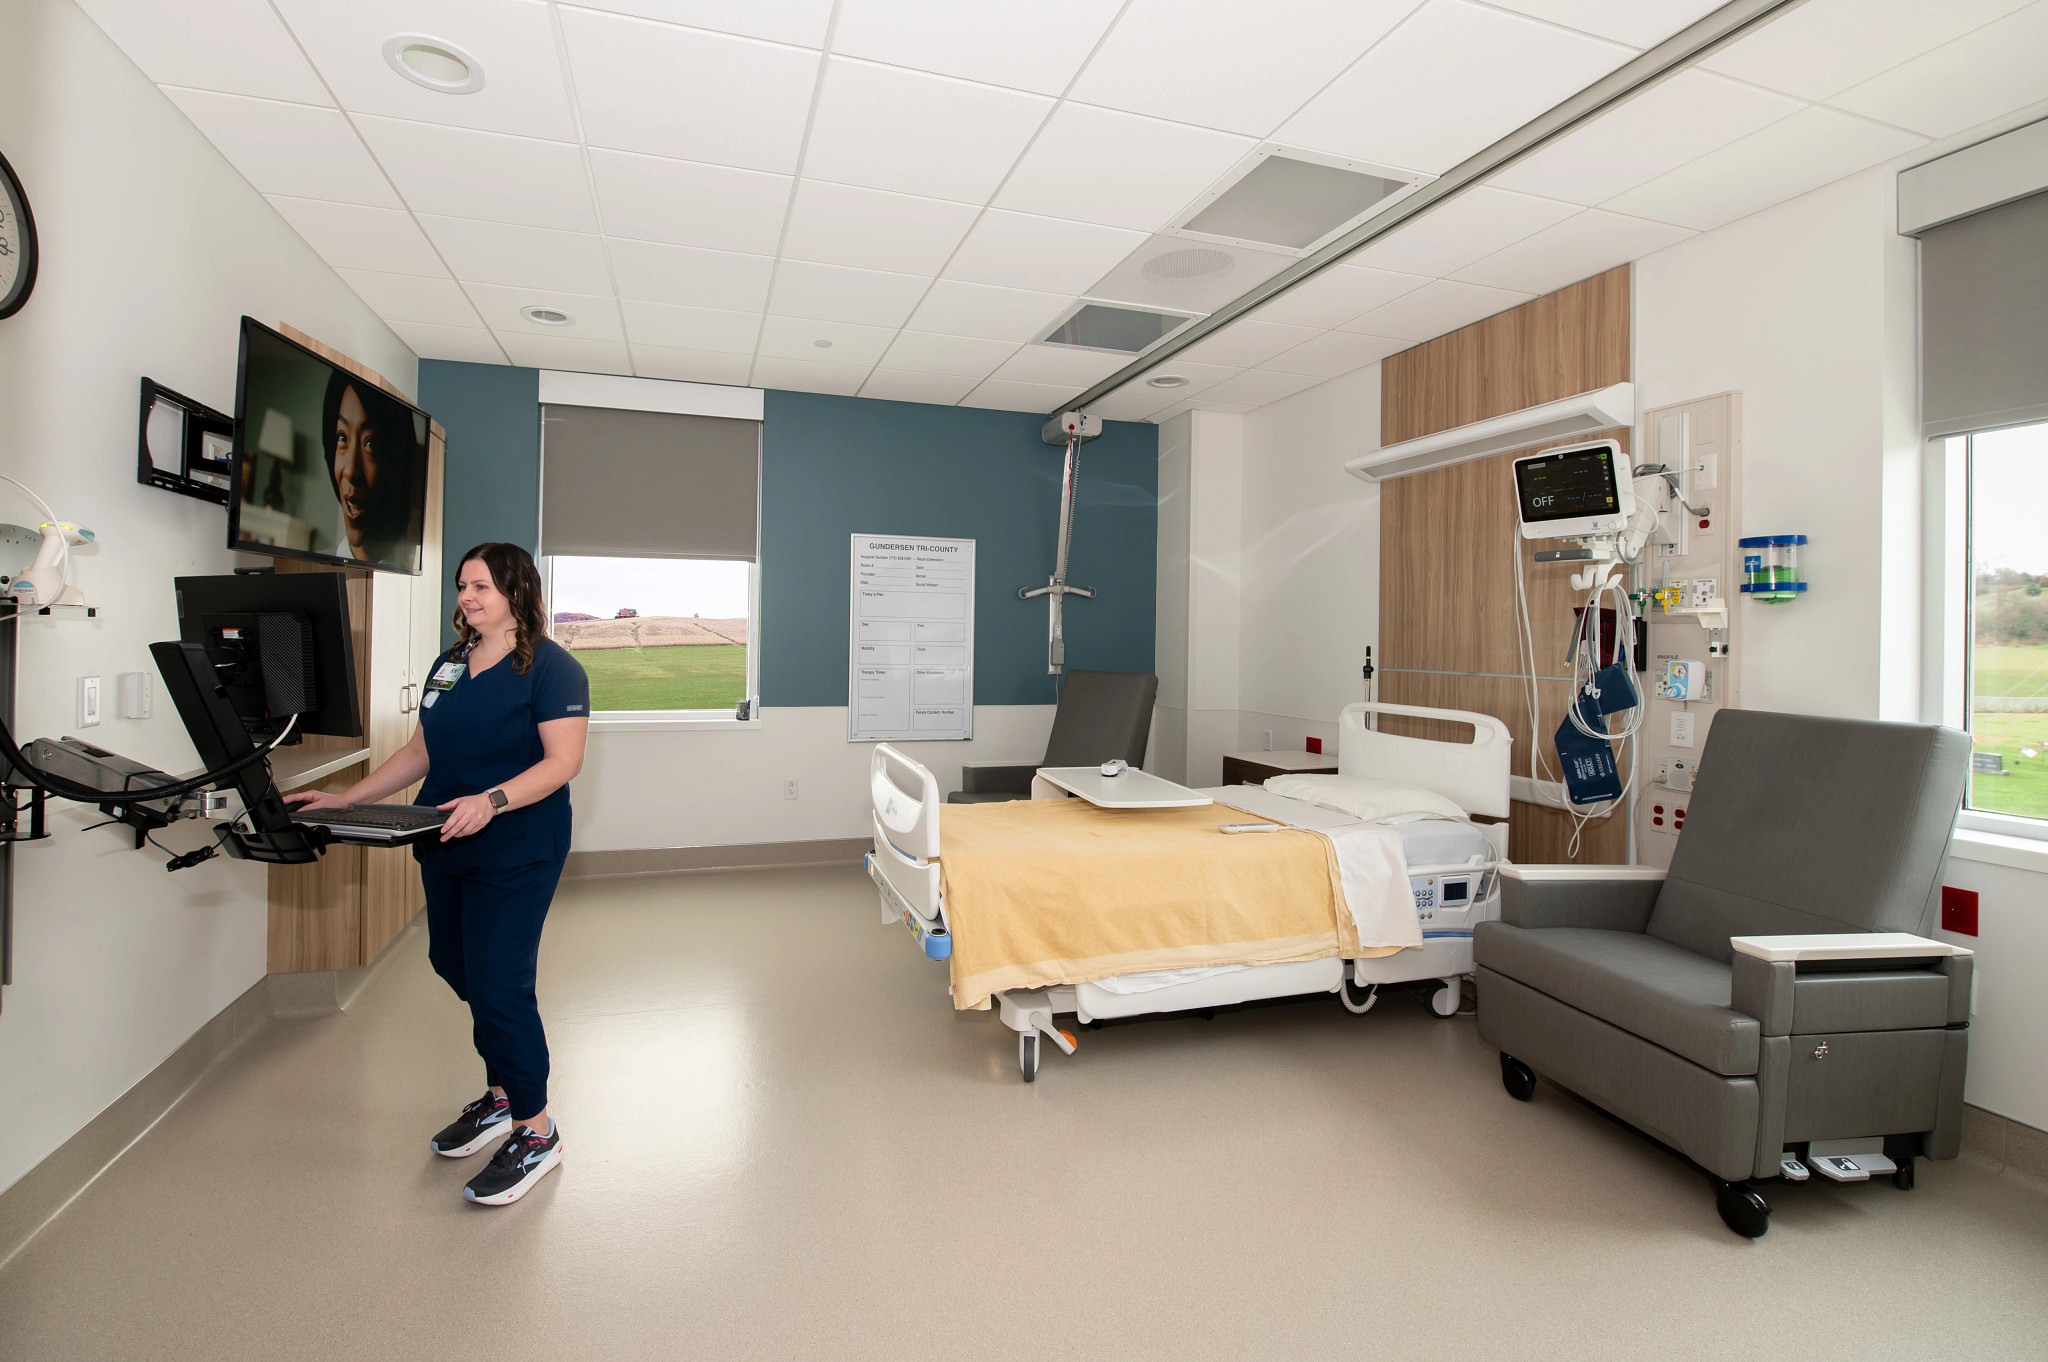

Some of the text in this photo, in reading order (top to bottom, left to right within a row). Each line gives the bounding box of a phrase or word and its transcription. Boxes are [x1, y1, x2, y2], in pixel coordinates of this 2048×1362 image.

[1532, 495, 1555, 508] OFF
[869, 542, 959, 553] GUNDERSEN TRI-COUNTY
